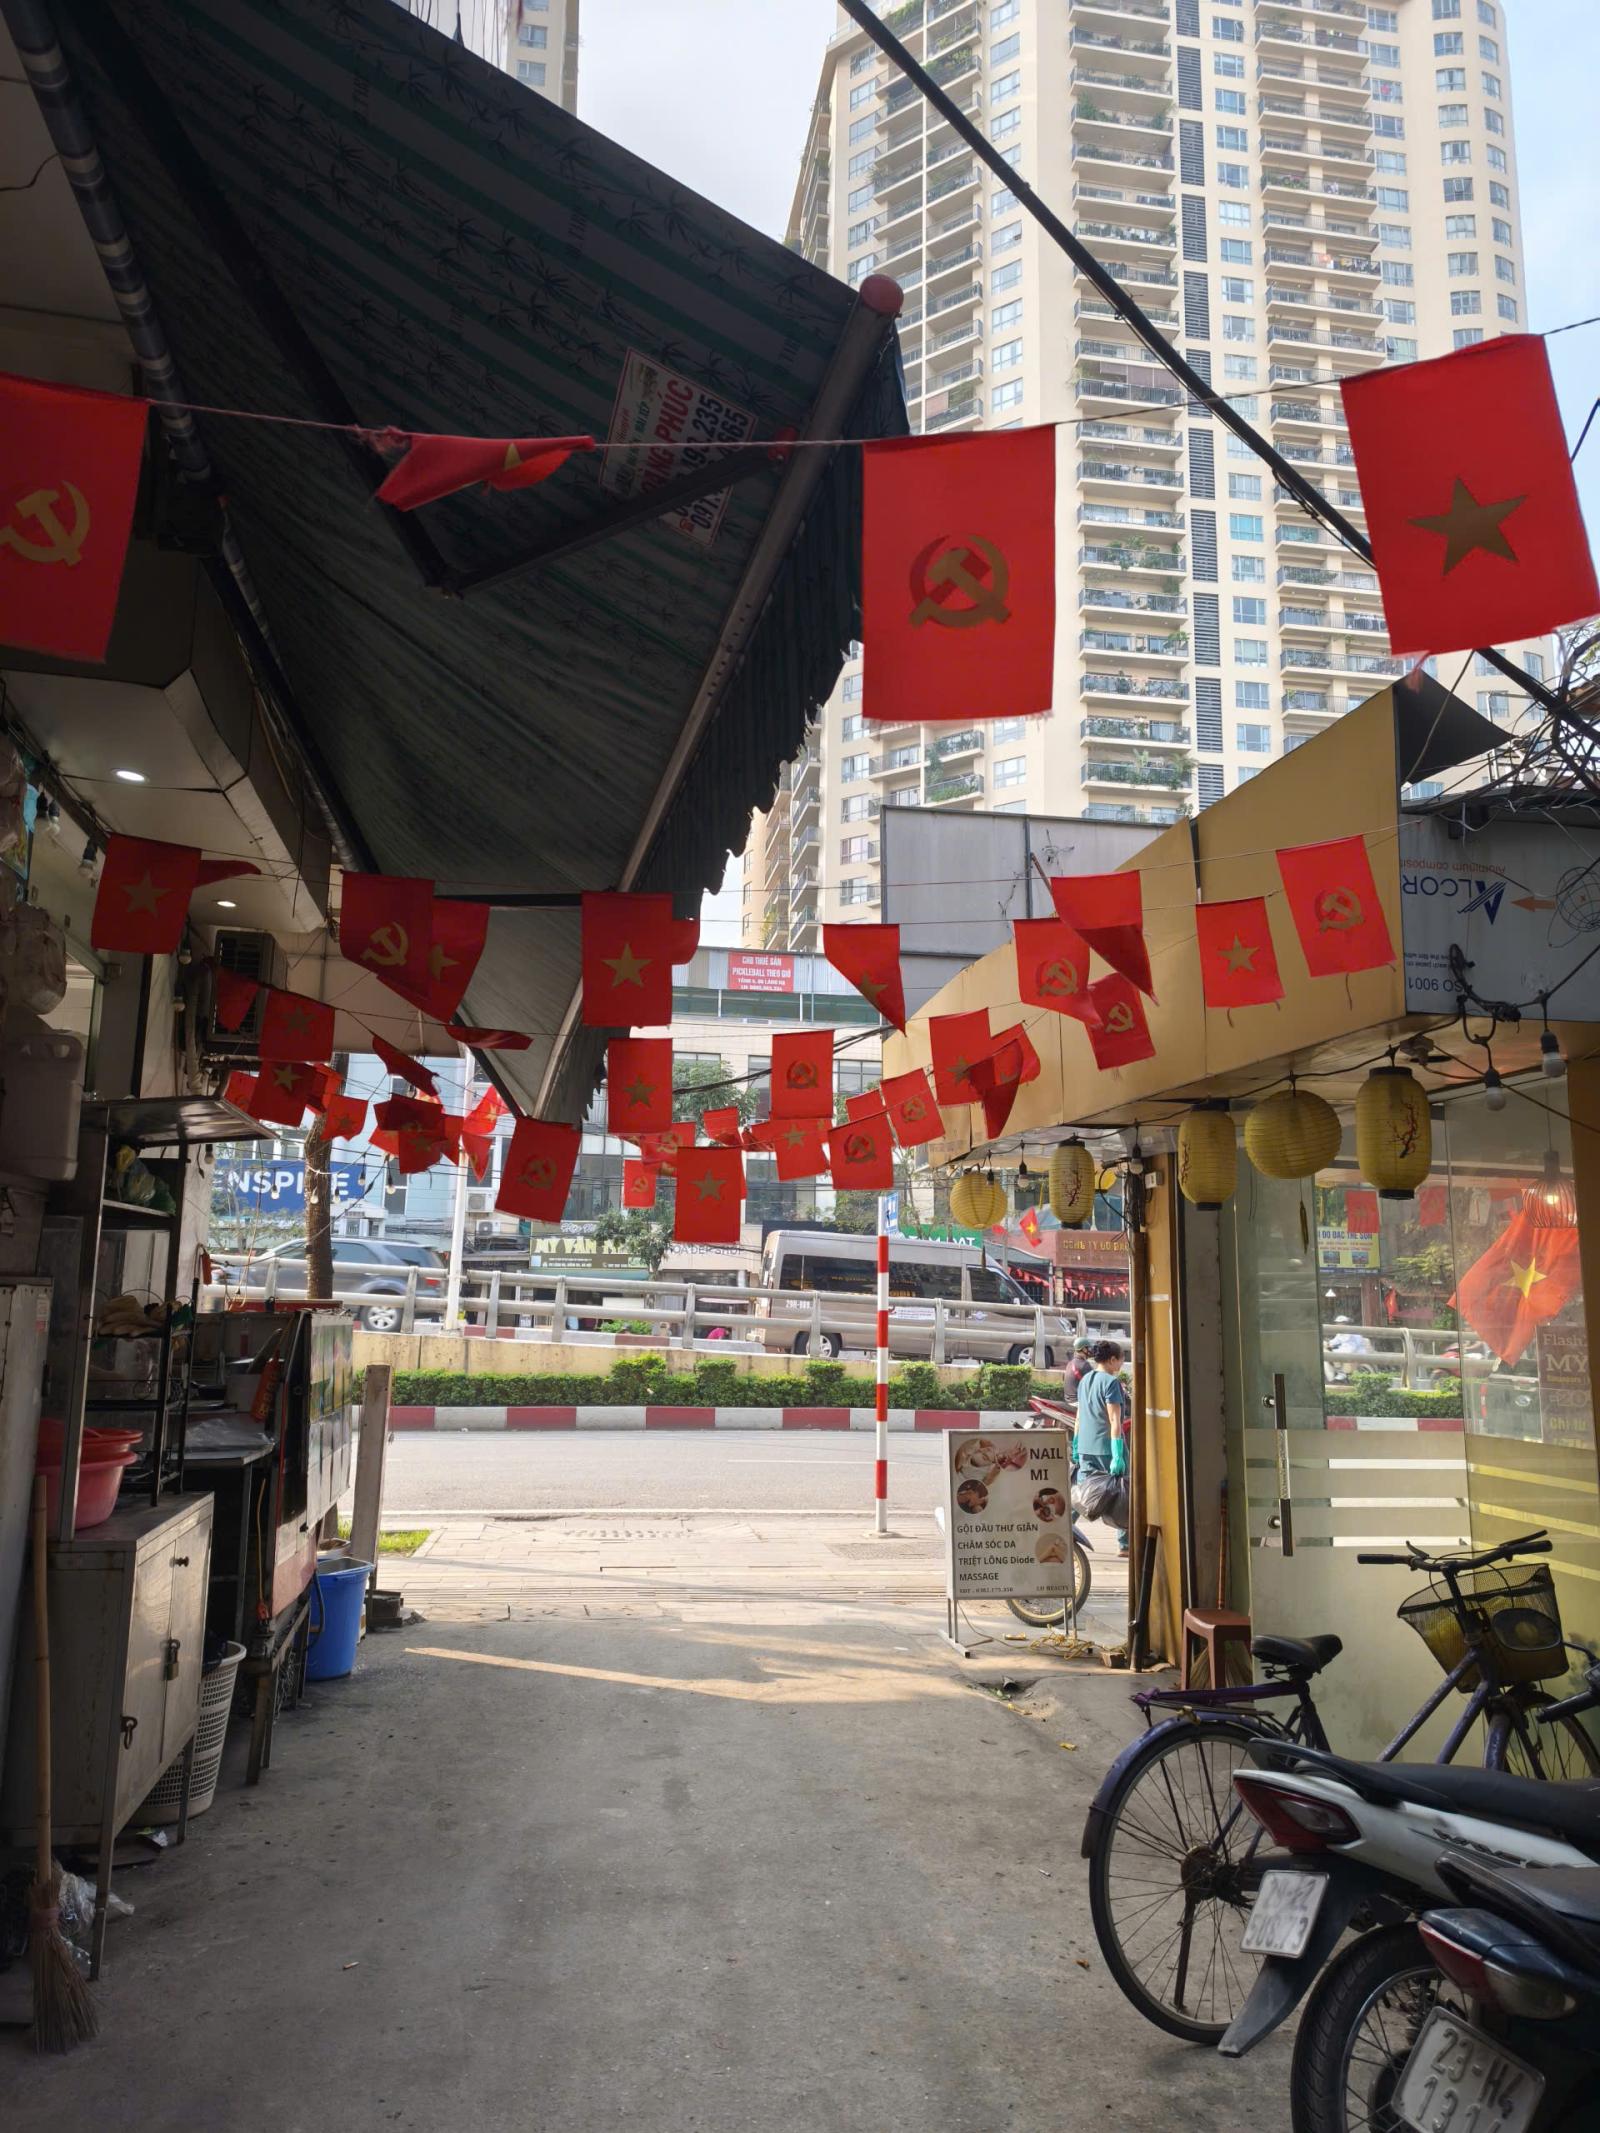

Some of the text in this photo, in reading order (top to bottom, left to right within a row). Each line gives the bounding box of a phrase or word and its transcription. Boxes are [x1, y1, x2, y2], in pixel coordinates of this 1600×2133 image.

[654, 379, 693, 443] PHÚC
[1402, 874, 1506, 925] ALCOR
[732, 967, 765, 977] PICKLEBALL
[1408, 977, 1440, 992] 9001
[212, 1170, 350, 1196] ENSPIE
[1030, 1447, 1064, 1460] NAIL
[1030, 1469, 1049, 1481] MI
[957, 1523, 1038, 1534] GỘI ĐẦU THƯ GIÃN
[985, 1539, 1002, 1549] SÓC
[1004, 1540, 1016, 1549] DA
[958, 1555, 1035, 1567] TRIỆT LÔNG Diode
[959, 1572, 1000, 1581] MASSAGE
[1415, 2075, 1502, 2133] 131
